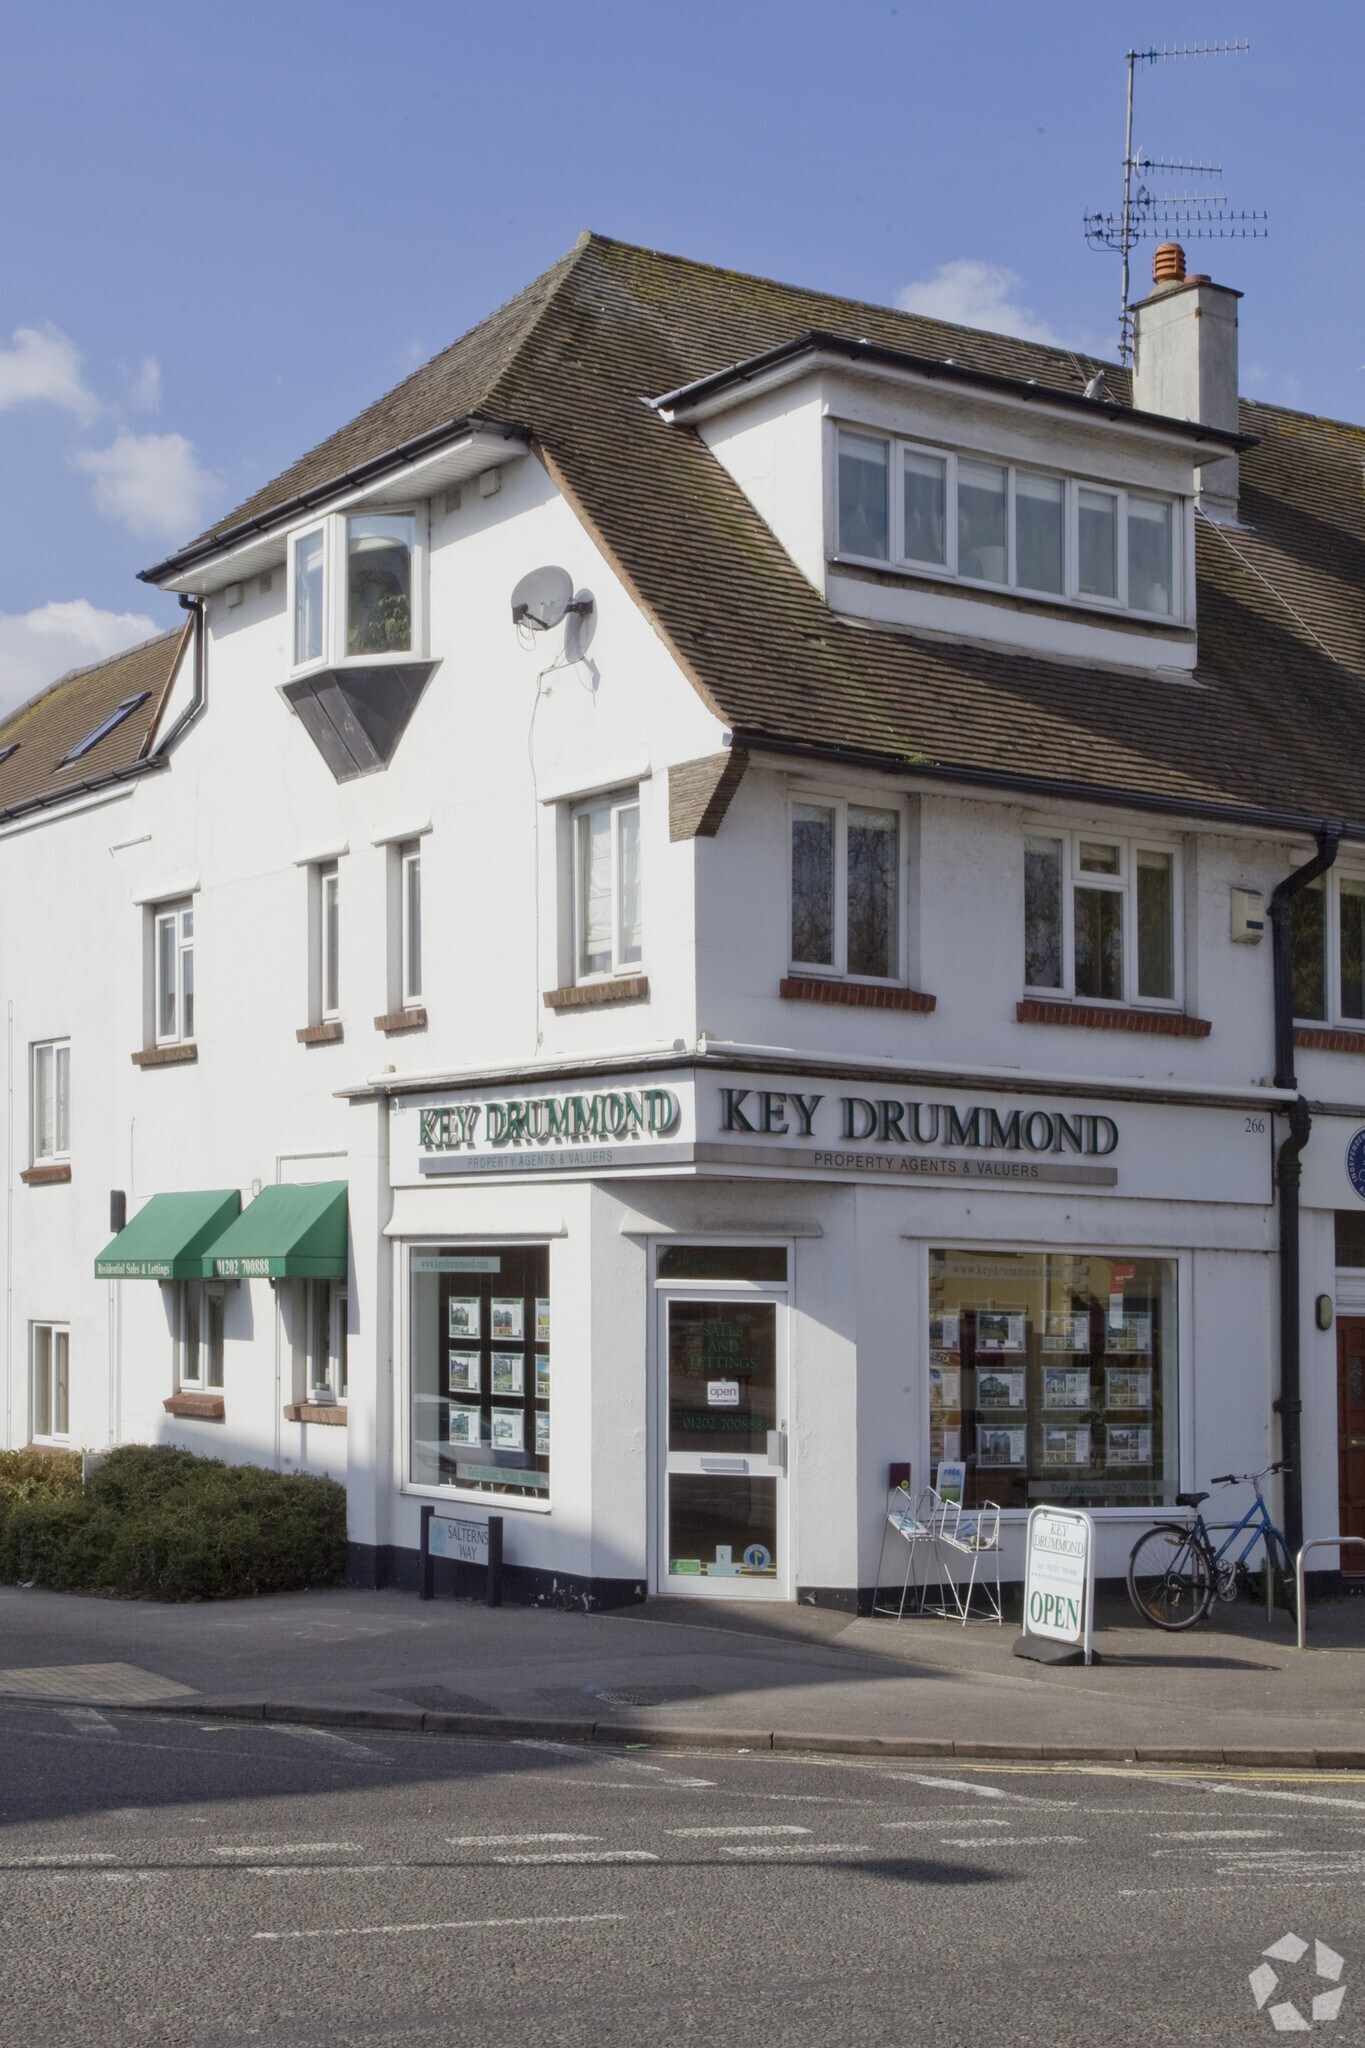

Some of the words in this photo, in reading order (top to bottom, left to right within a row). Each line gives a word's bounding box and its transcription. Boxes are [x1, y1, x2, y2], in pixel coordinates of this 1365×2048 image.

[418, 1104, 479, 1146] KEY
[485, 1088, 678, 1141] DRUMMOND
[718, 1088, 825, 1136] KEY
[840, 1097, 1119, 1155] DRUMMOND
[1245, 1117, 1265, 1134] 266
[468, 1155, 516, 1169] PROPERTY
[519, 1153, 556, 1167] AGENTS
[559, 1153, 565, 1165] &
[568, 1151, 613, 1165] VALUERS
[814, 1152, 894, 1170] PROPERTY
[900, 1158, 957, 1173] AGENTS
[963, 1161, 971, 1174] &
[977, 1162, 1039, 1178] VALUERS
[97, 1263, 125, 1275] Residential
[126, 1263, 140, 1275] Sales
[141, 1263, 147, 1275] &
[148, 1263, 170, 1277] Lettings
[217, 1260, 239, 1275] 01202
[242, 1259, 269, 1274] 700888
[953, 1264, 1063, 1278] www.keydrummond.com
[703, 1325, 743, 1337] SALES
[708, 1340, 739, 1353] AND
[710, 1387, 737, 1398] open
[683, 1417, 716, 1429] 01202
[1051, 1483, 1099, 1496] Telephone:
[1103, 1483, 1126, 1494] 01202
[448, 1525, 488, 1546] SALTERNS
[1050, 1523, 1069, 1537] KEY
[459, 1544, 477, 1561] WAY
[1034, 1535, 1084, 1555] DRUMMOND
[1030, 1590, 1080, 1632] OPEN
